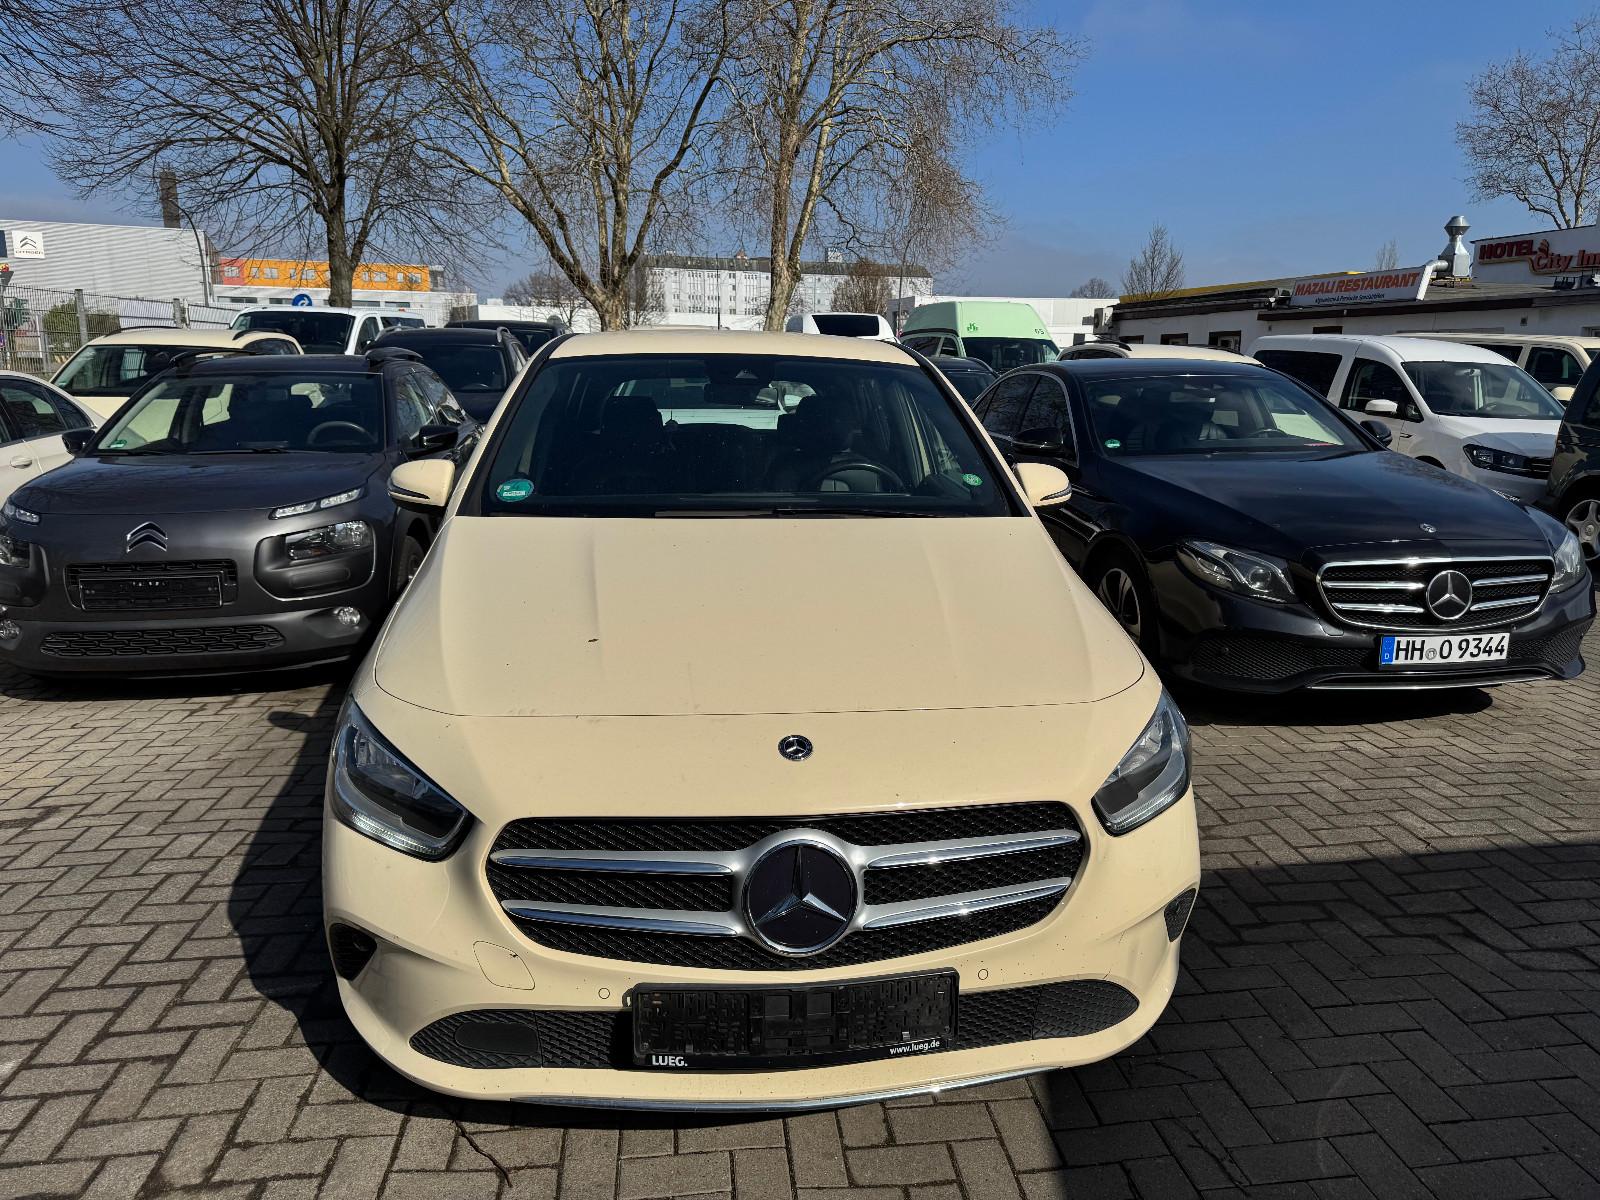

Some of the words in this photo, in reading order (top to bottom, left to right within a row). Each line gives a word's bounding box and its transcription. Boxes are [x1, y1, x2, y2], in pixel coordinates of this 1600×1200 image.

[1479, 240, 1536, 260] HOTEL
[1535, 252, 1573, 272] City
[1296, 279, 1338, 296] MAZALI
[1336, 272, 1420, 293] RESTAURANT
[1395, 639, 1425, 661] HH
[1458, 635, 1506, 659] 9344
[889, 1039, 940, 1055] www.lueg.de
[651, 1054, 688, 1067] LUEG.
